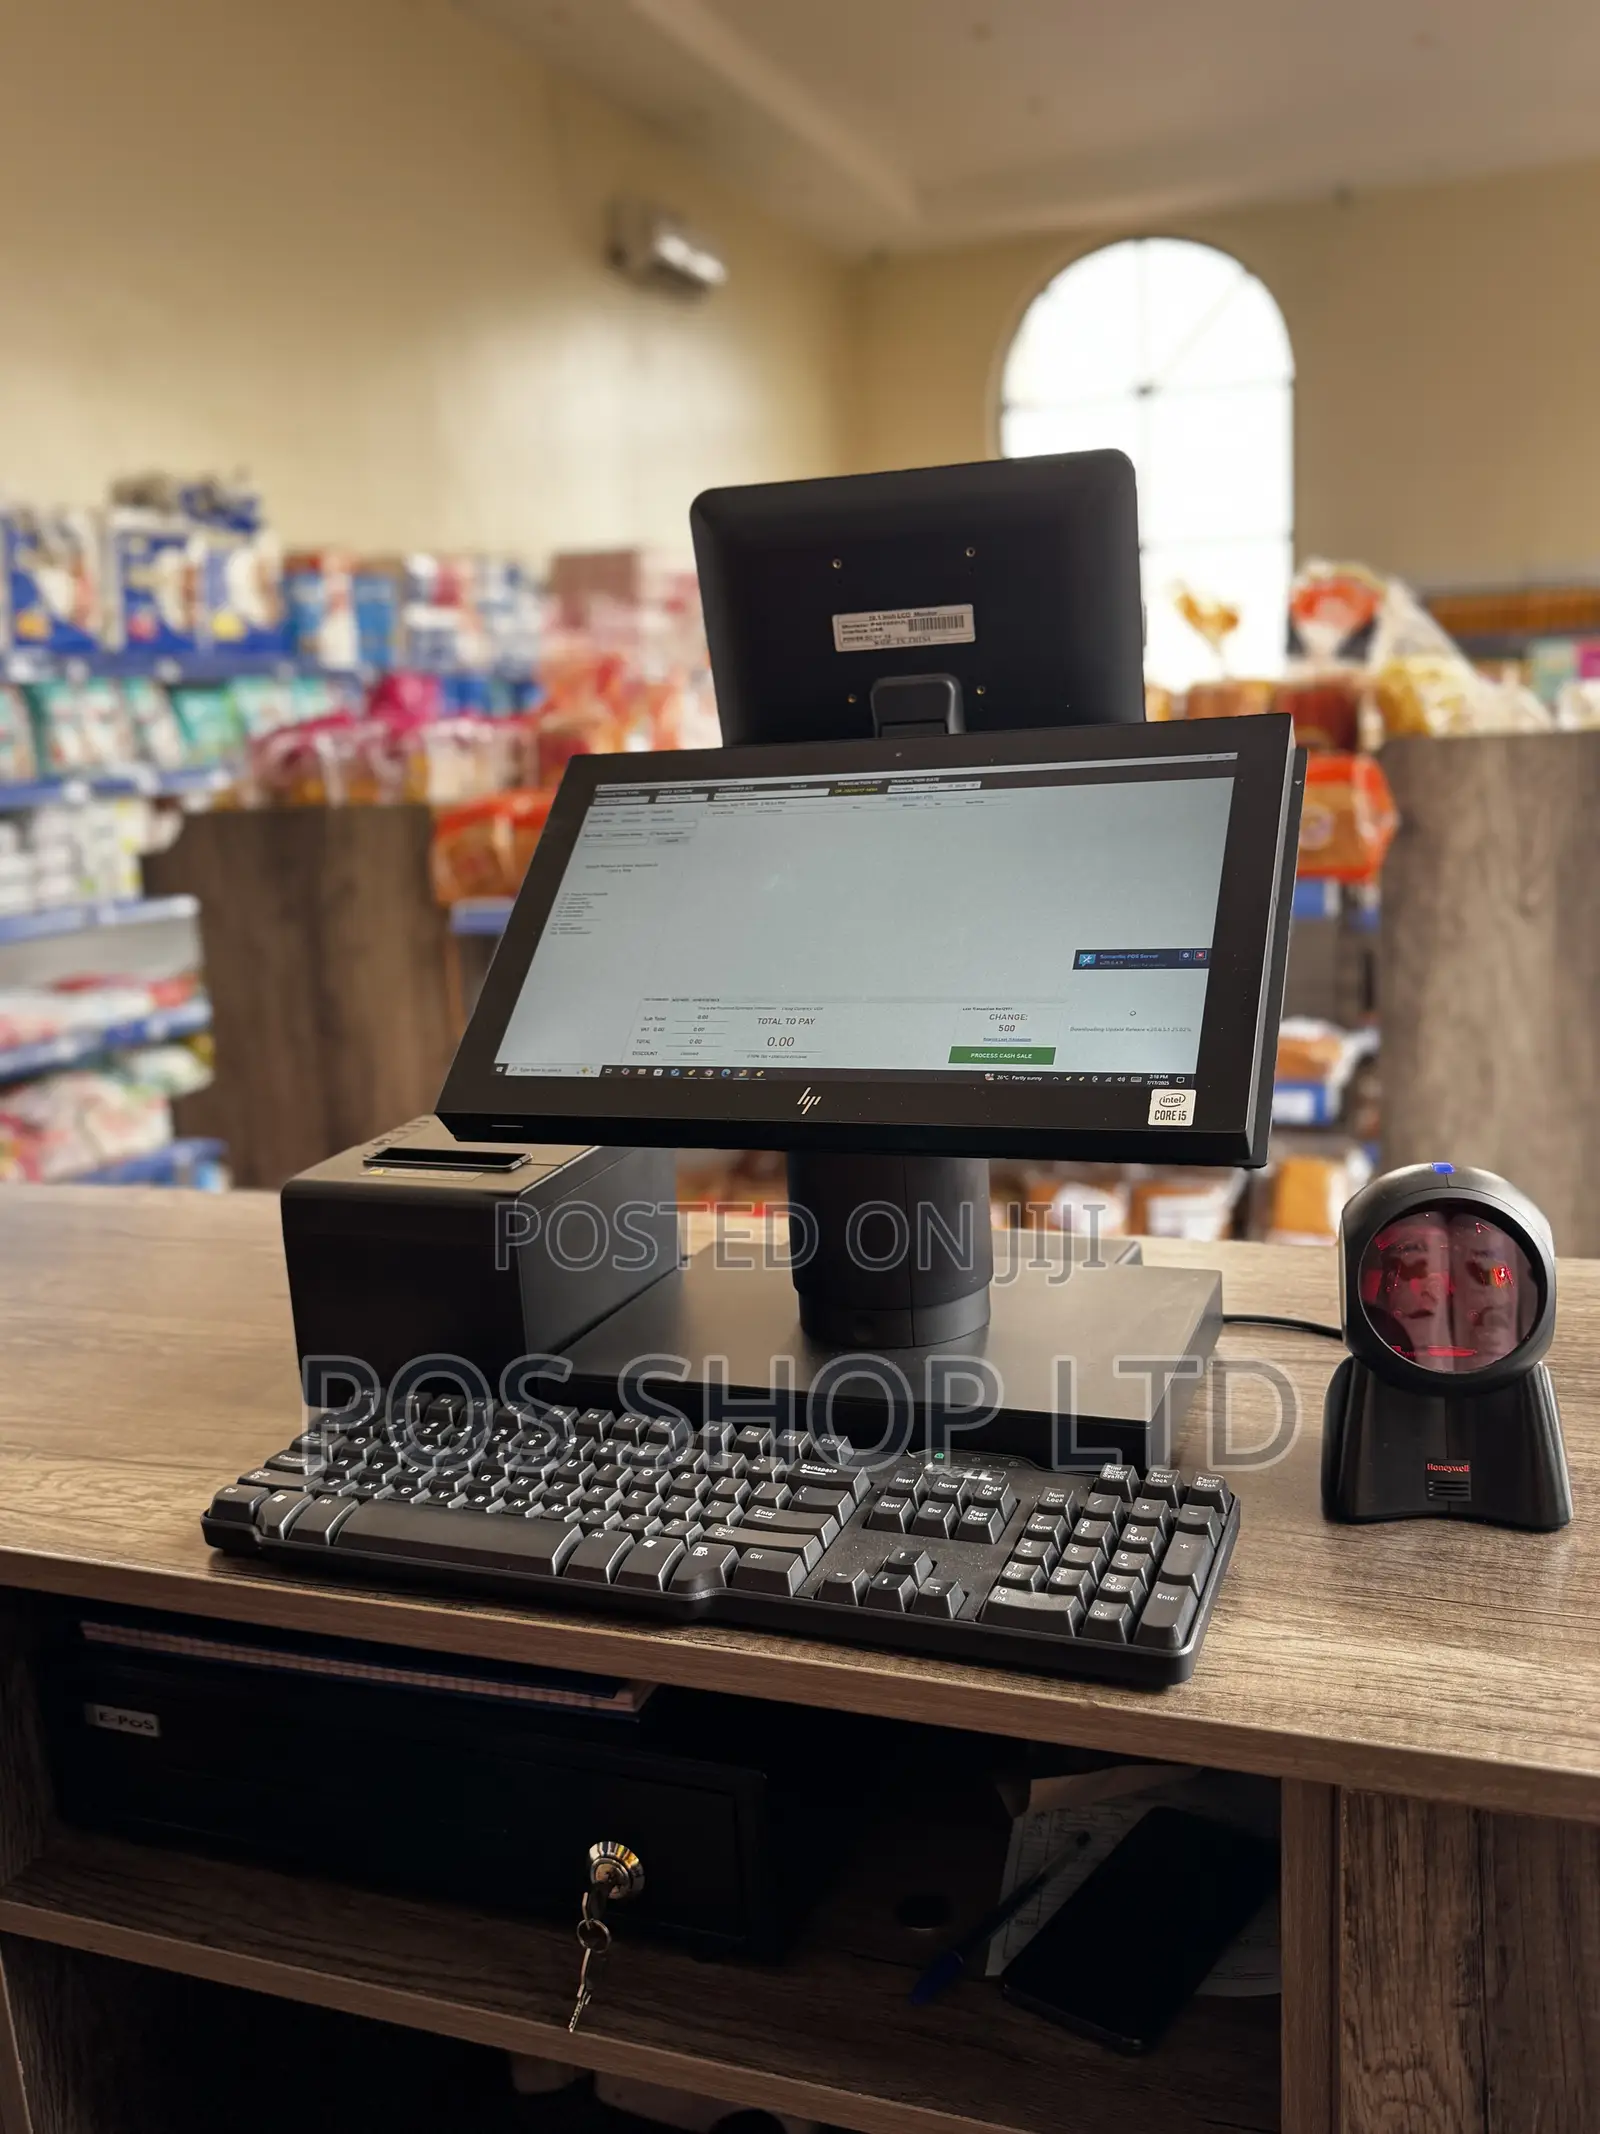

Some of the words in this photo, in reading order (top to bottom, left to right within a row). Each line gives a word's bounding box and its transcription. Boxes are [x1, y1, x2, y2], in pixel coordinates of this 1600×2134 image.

[998, 1024, 1016, 1032] 500
[767, 1037, 795, 1047] 0.00
[1154, 1110, 1176, 1120] CORE
[1178, 1110, 1187, 1120] i5
[801, 1463, 838, 1474] Backspace
[1427, 1463, 1470, 1473] Honeywell
[938, 1481, 958, 1489] Home
[984, 1484, 1002, 1492] Page
[1048, 1491, 1065, 1499] Num
[1046, 1496, 1064, 1504] Lock
[880, 1500, 901, 1509] Delete
[755, 1509, 776, 1518] Enter
[970, 1509, 988, 1517] Page
[716, 1526, 735, 1535] Shift
[1030, 1523, 1053, 1531] Home
[592, 1531, 604, 1539] Alt
[750, 1552, 765, 1560] Ctrl
[1006, 1570, 1022, 1578] End
[1105, 1582, 1127, 1591] PgDn
[1156, 1593, 1178, 1601] Enter
[1094, 1609, 1108, 1617] Del
